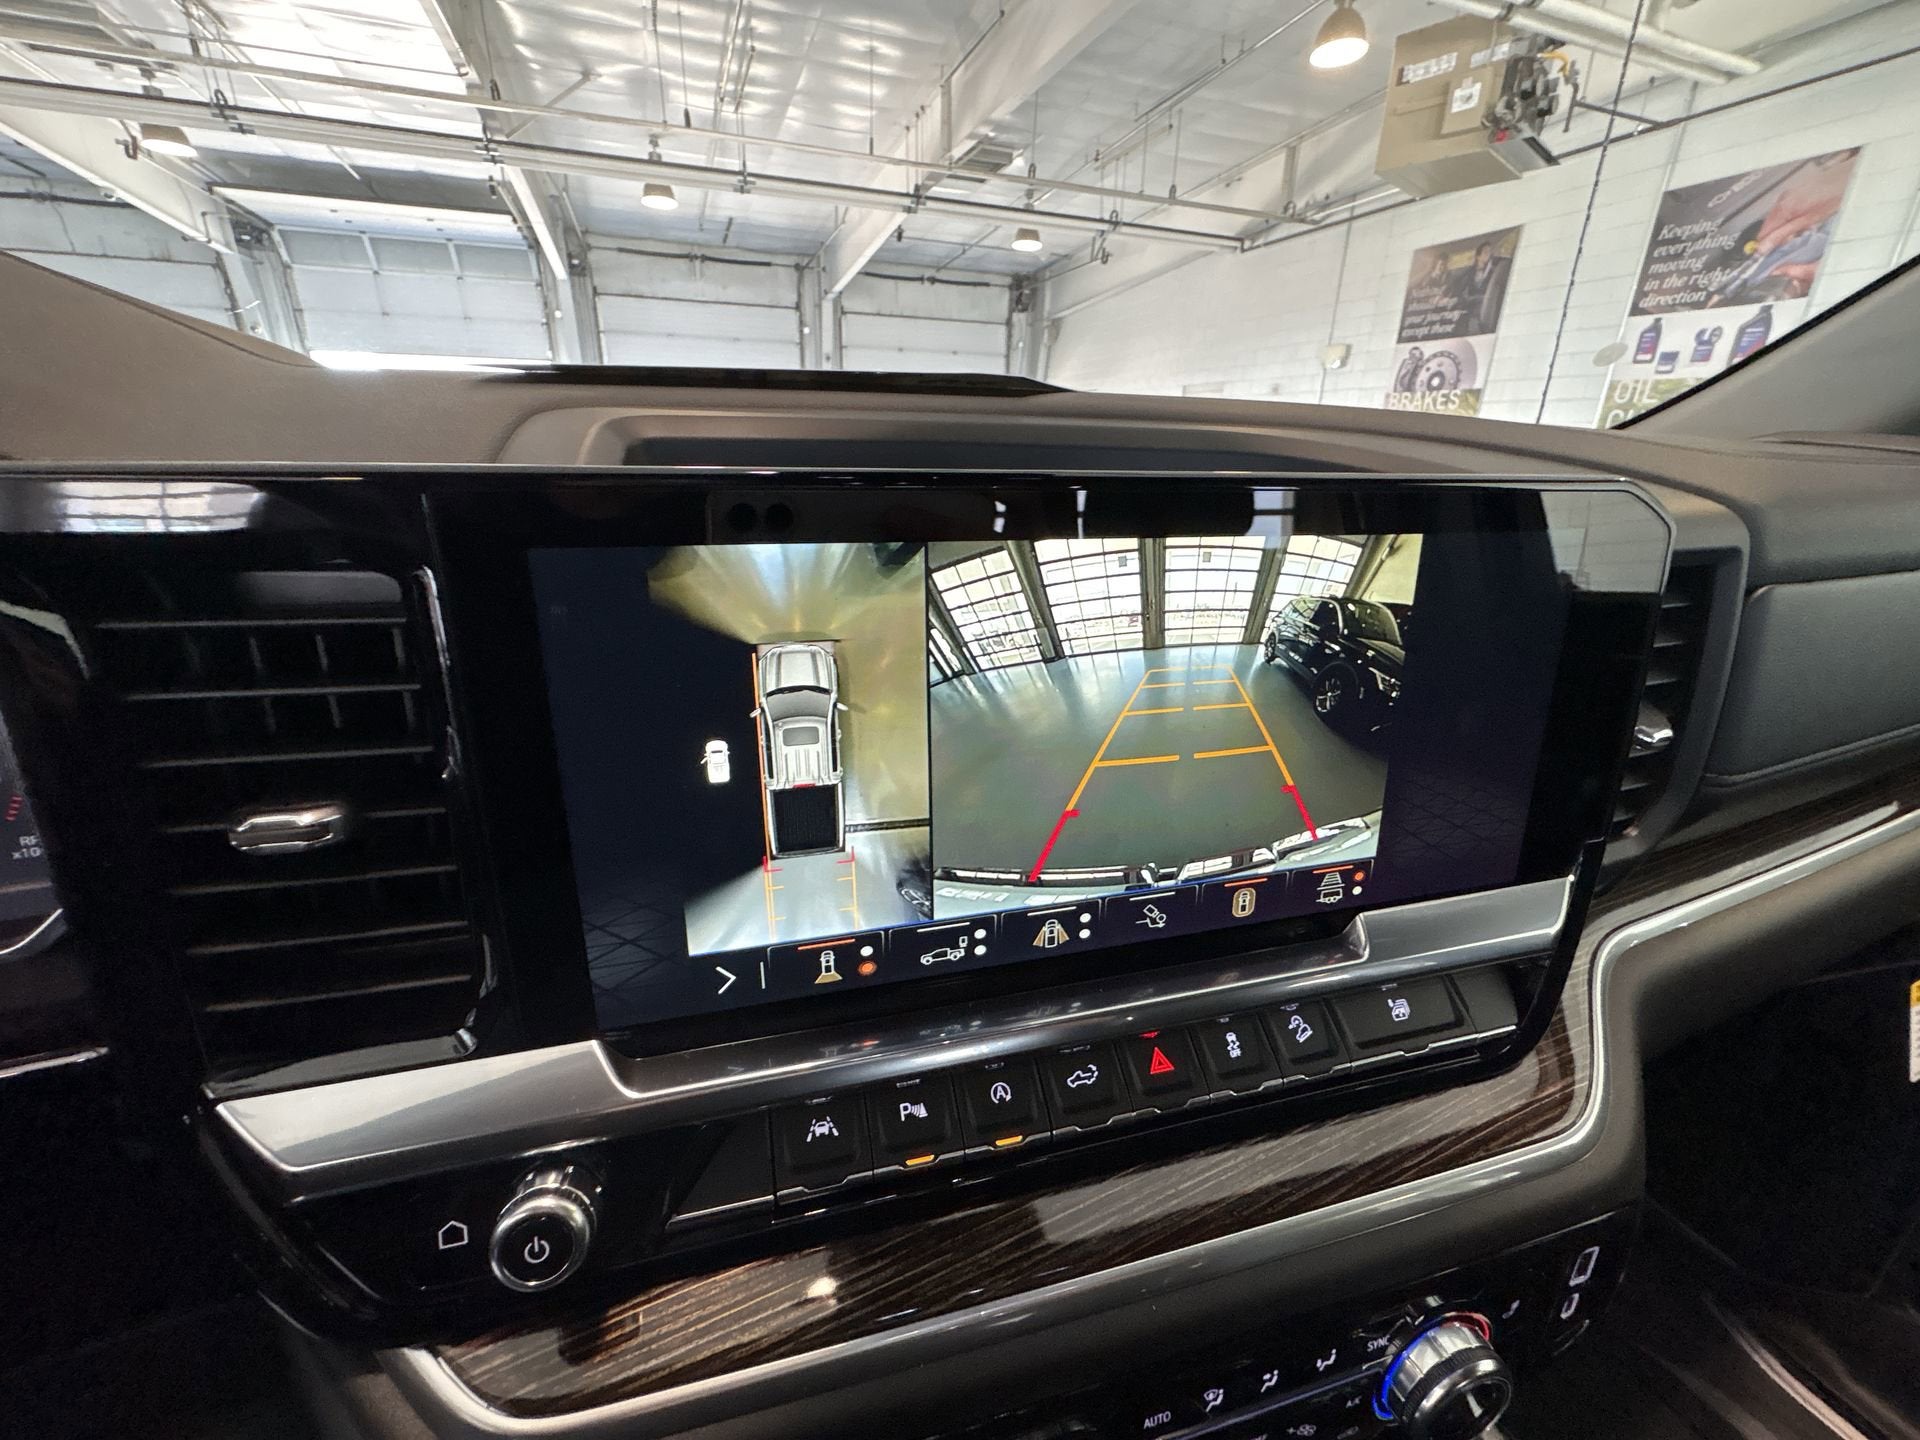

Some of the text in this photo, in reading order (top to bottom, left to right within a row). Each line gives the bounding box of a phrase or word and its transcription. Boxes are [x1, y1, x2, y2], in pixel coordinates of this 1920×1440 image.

[1657, 217, 1724, 240] Keeping
[1652, 231, 1740, 259] everything
[1648, 254, 1709, 274] moving
[1644, 267, 1730, 291] in the right
[1638, 288, 1707, 308] direction
[1389, 389, 1461, 411] BRAKES
[1613, 378, 1659, 403] OIL
[11, 847, 42, 859] x10
[1367, 1335, 1391, 1352] SYNC
[1143, 1411, 1171, 1430] AUTO
